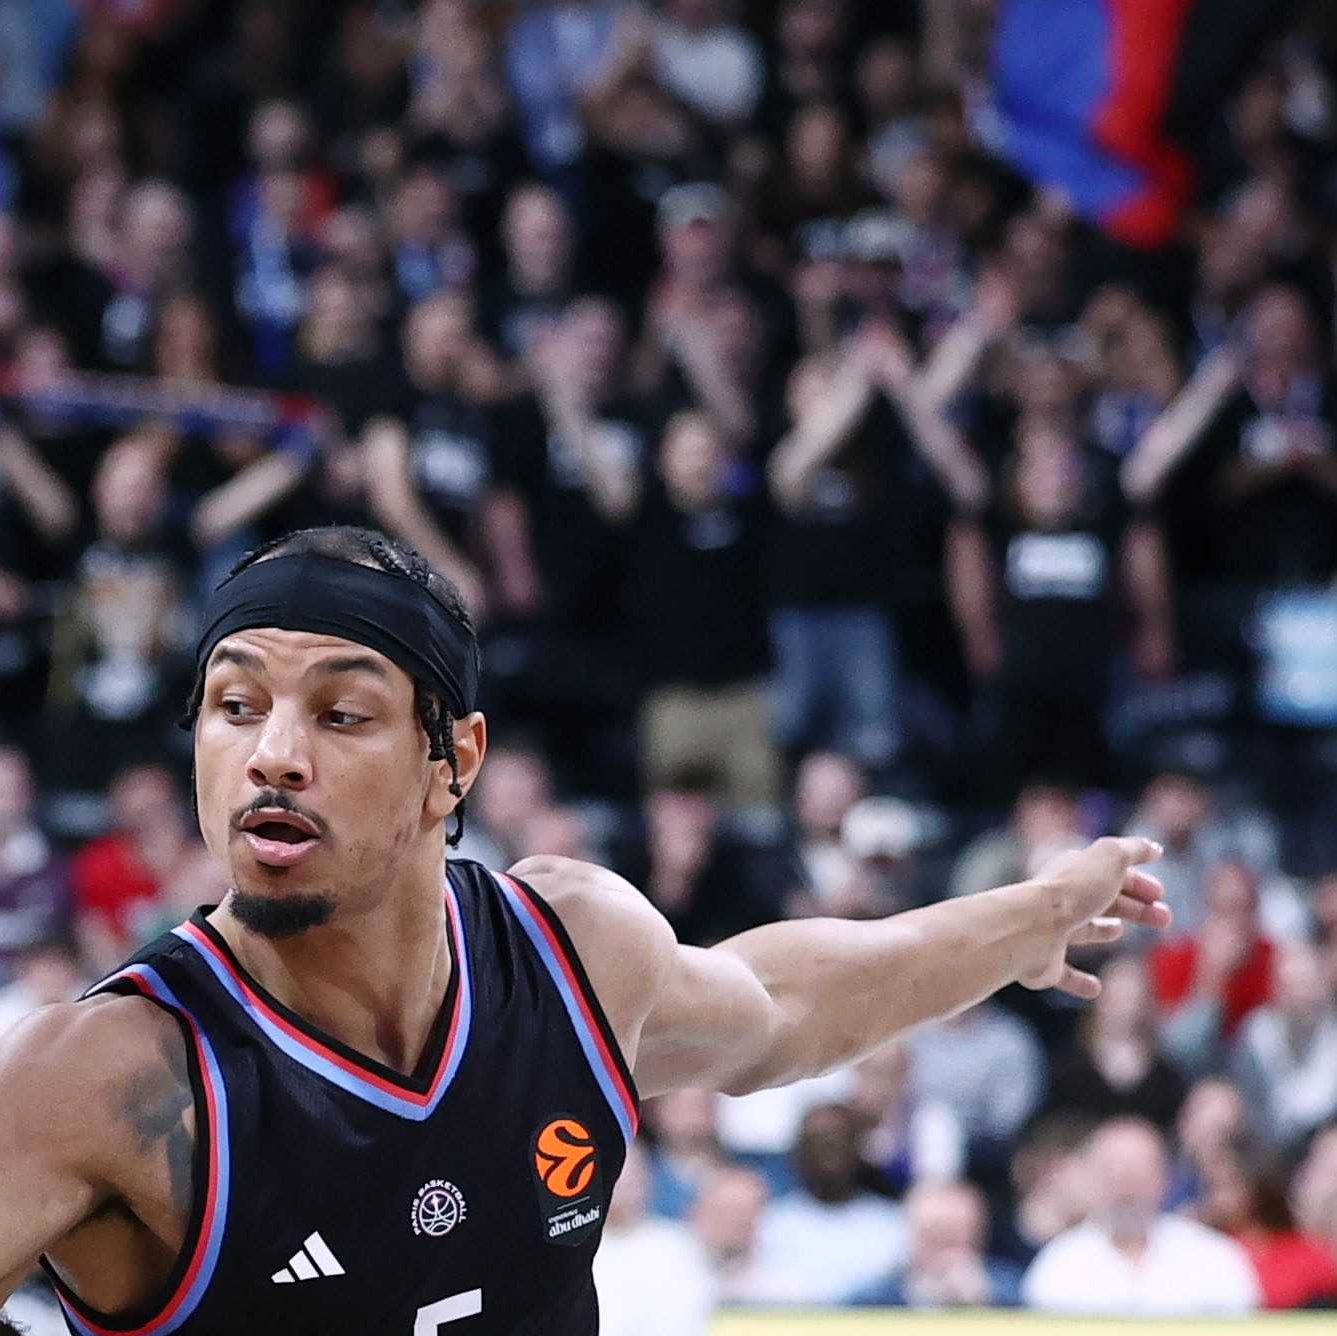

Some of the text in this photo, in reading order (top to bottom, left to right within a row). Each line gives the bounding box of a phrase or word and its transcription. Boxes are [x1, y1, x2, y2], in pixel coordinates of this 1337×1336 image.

[411, 1179, 467, 1236] PARIS BASKETBALL
[549, 1205, 600, 1238] abu dhabi
